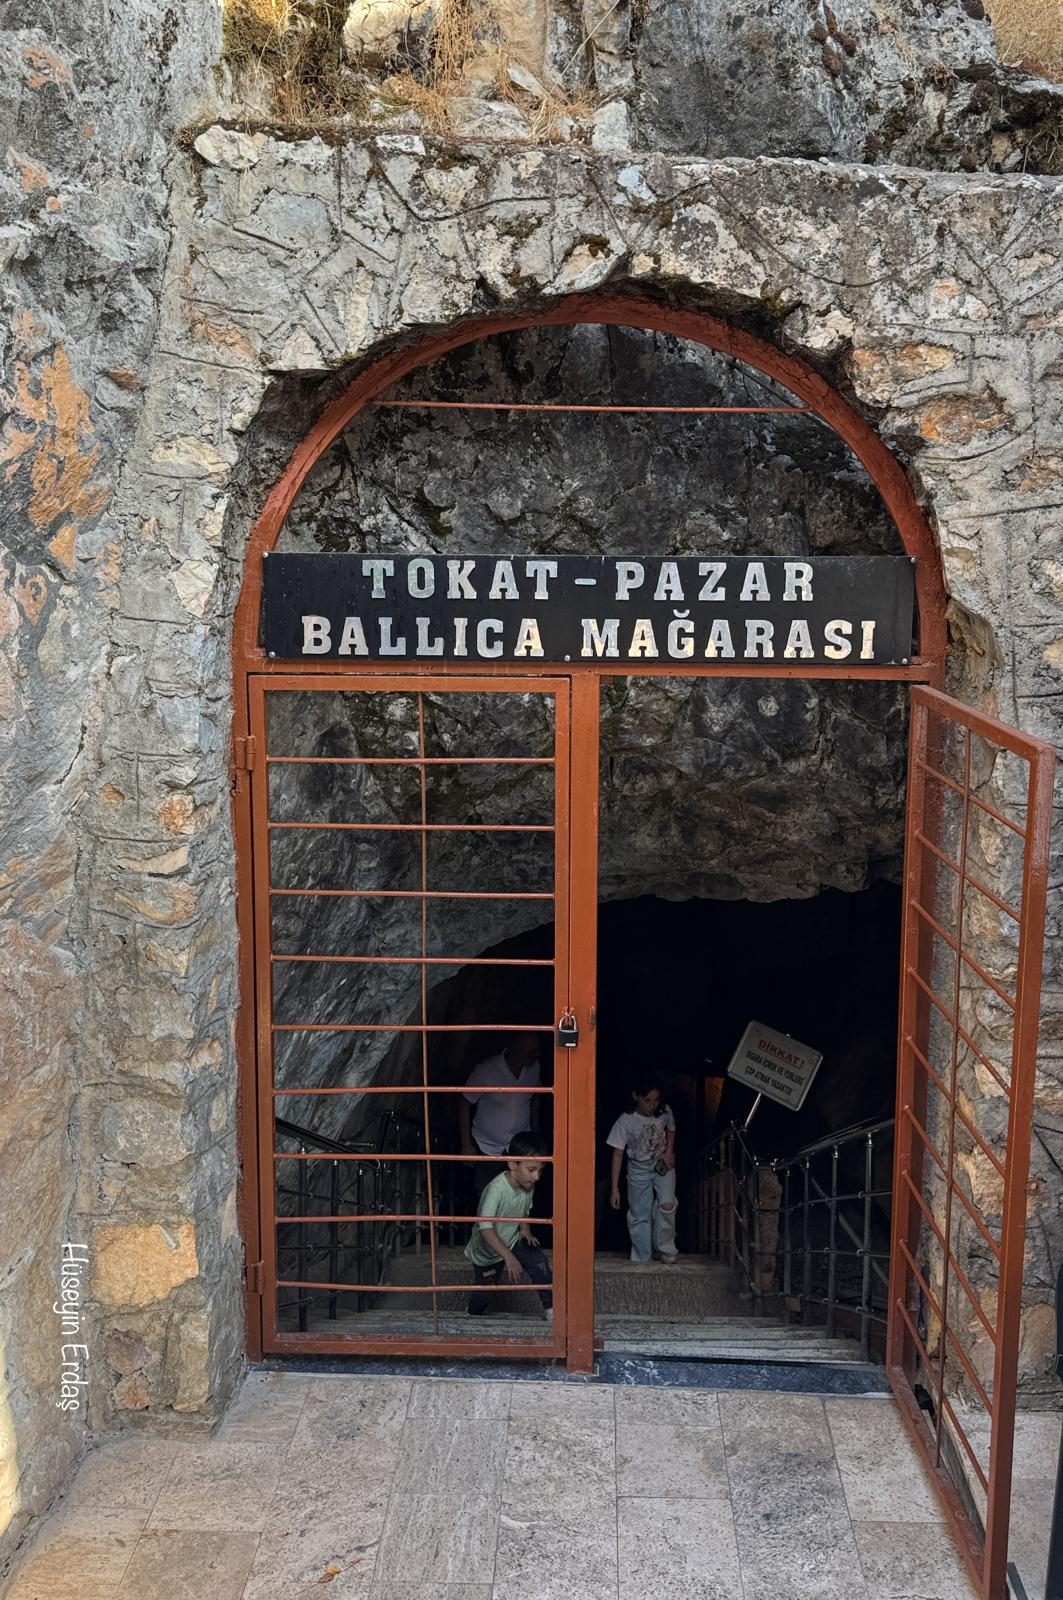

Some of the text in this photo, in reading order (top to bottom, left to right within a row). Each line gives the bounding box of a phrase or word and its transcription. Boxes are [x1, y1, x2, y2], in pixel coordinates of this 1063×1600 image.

[362, 558, 558, 599] TOKAT
[615, 561, 814, 601] PAZAR
[301, 608, 876, 659] BALLICA MAĞARASI
